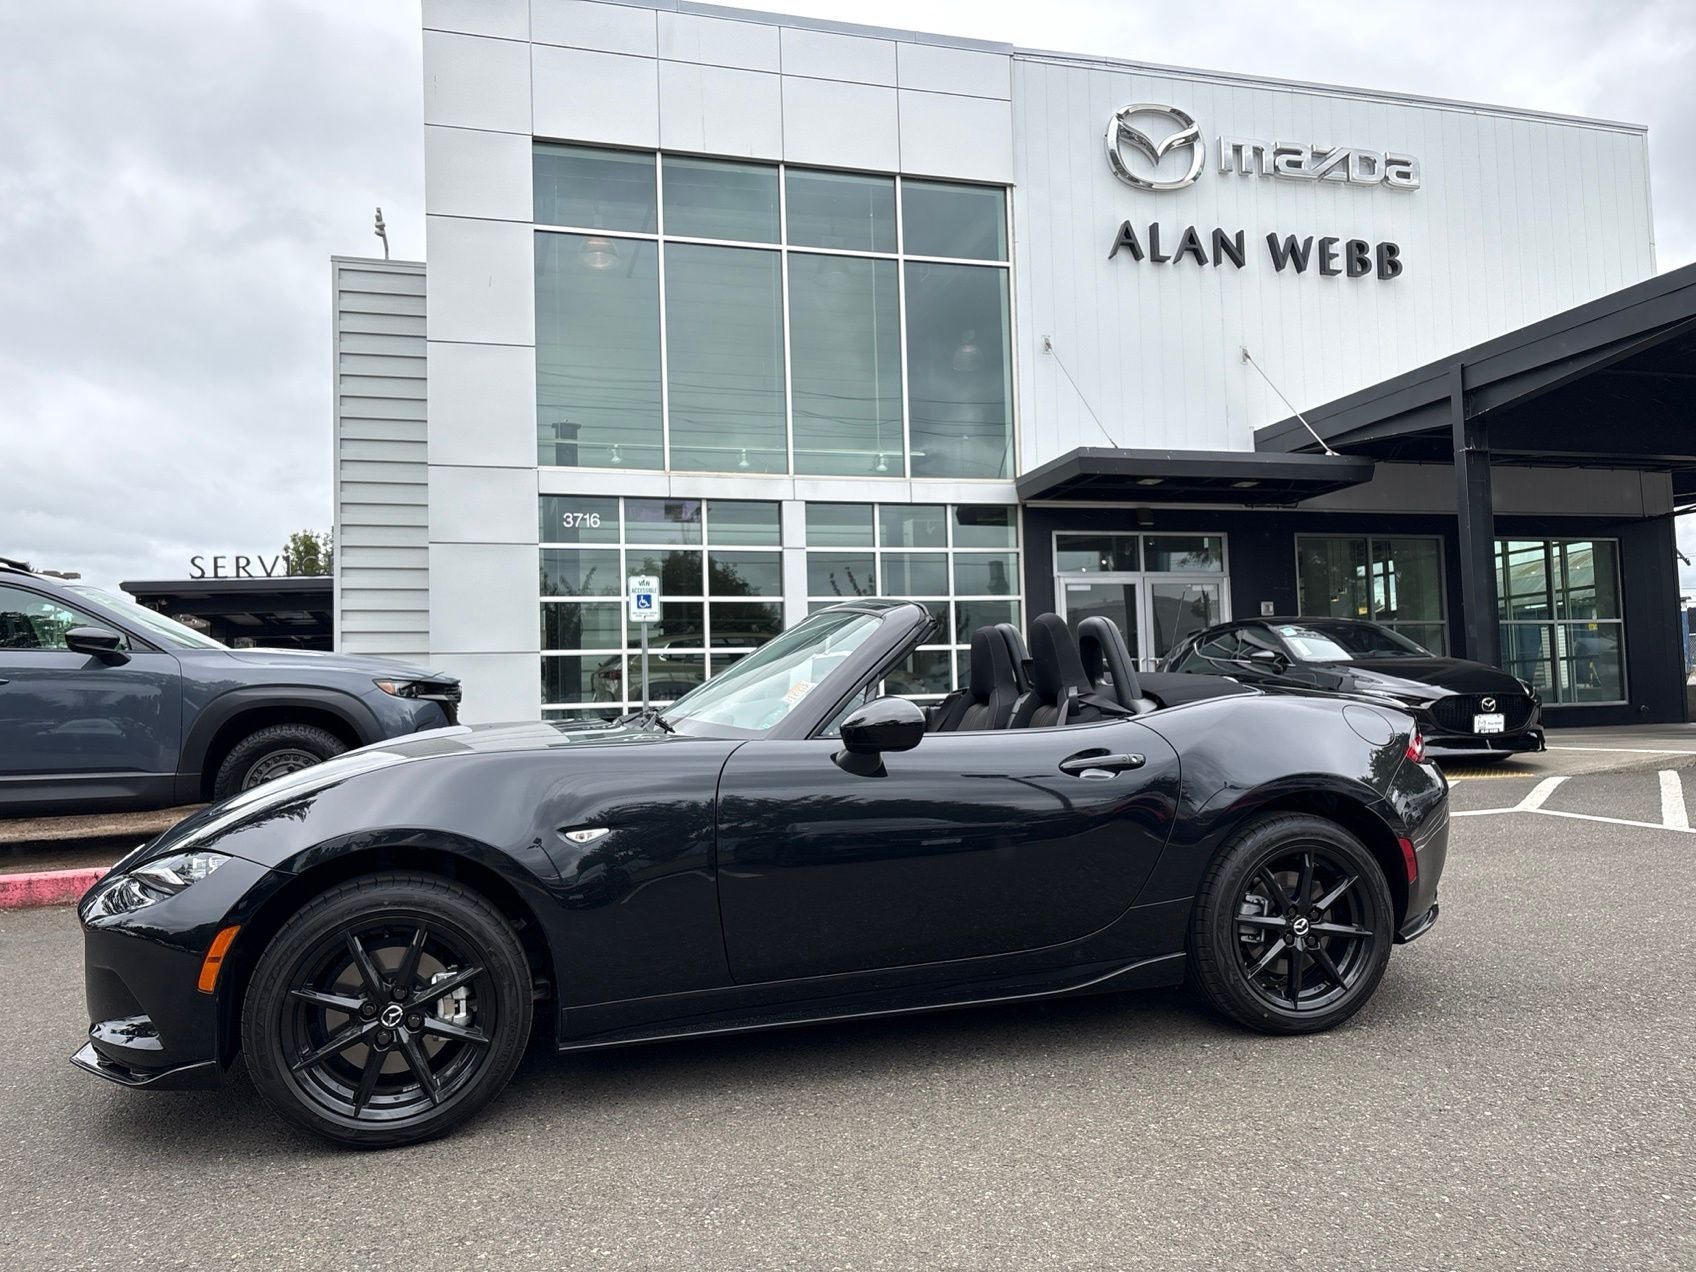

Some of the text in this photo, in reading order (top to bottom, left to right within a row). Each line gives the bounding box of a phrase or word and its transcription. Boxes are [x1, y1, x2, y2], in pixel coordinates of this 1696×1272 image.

[1107, 219, 1404, 280] ALAN WEBB
[563, 512, 601, 528] 3716
[189, 555, 334, 579] SERVIC
